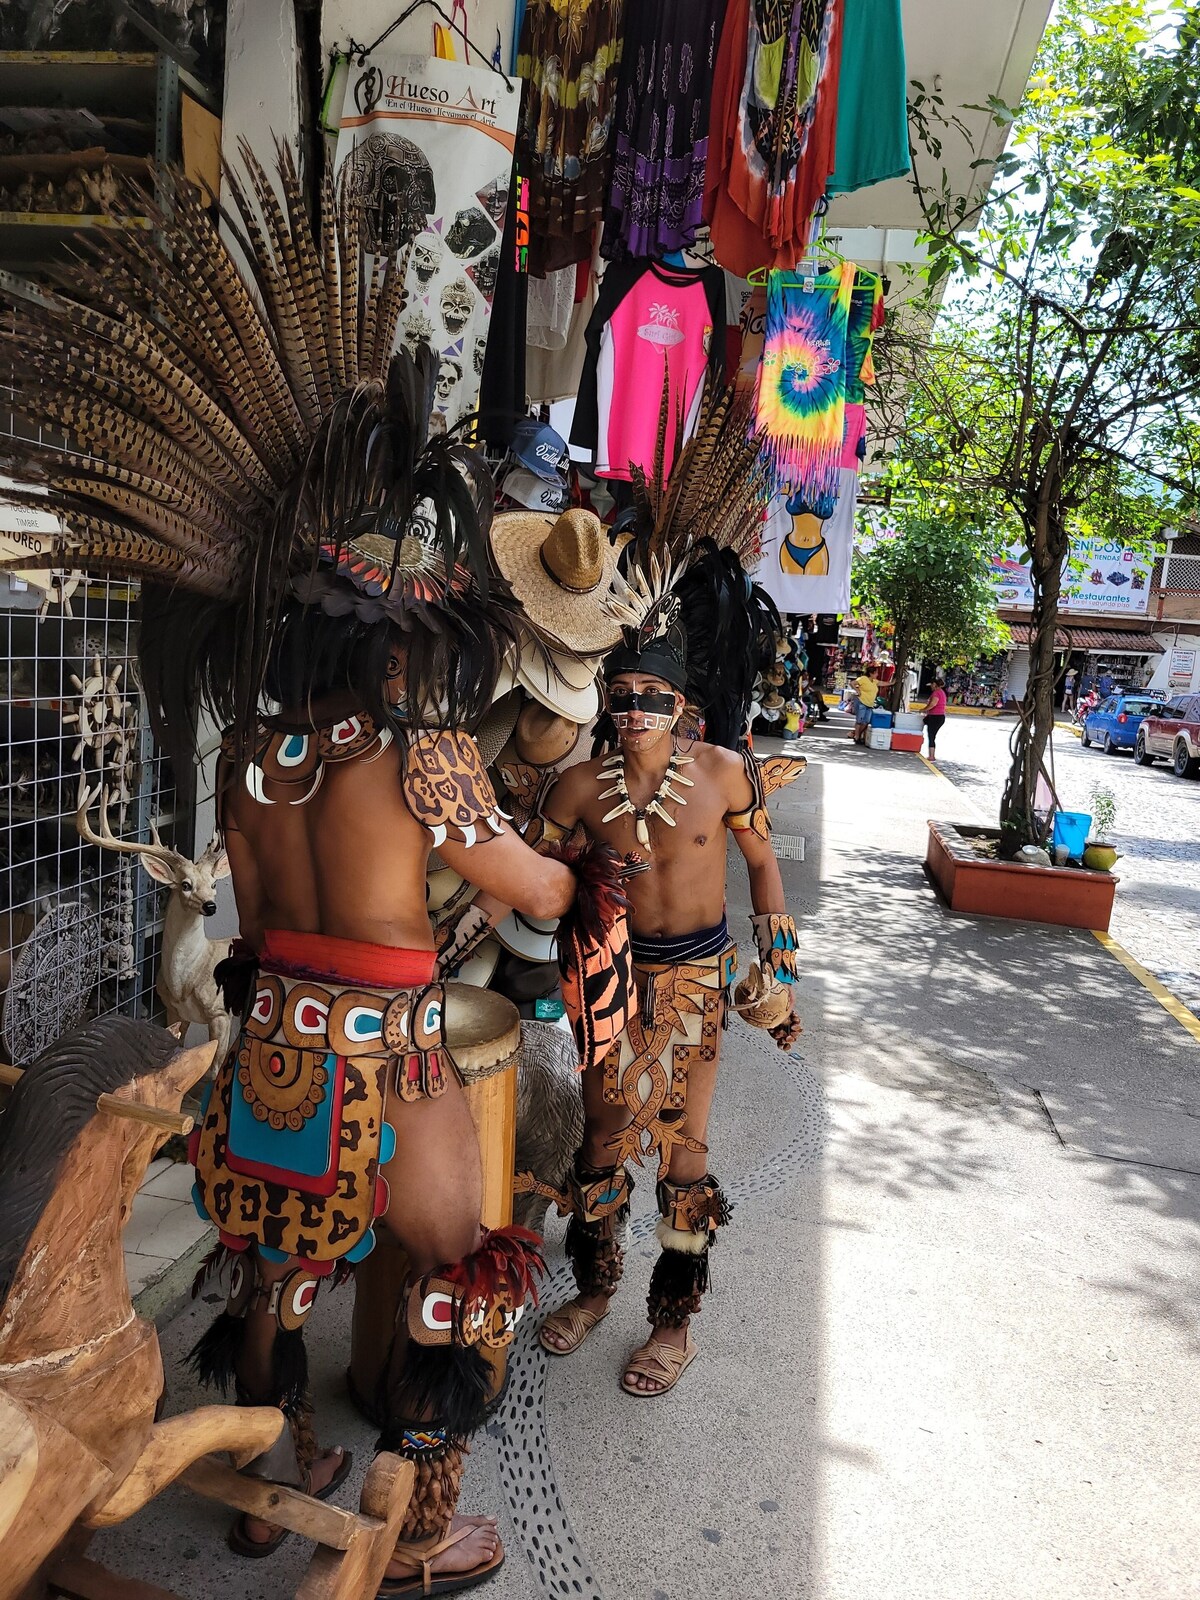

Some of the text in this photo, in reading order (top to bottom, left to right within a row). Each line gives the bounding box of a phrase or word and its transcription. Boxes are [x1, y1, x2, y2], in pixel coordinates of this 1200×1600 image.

[387, 75, 497, 114] Hueso Art
[386, 98, 398, 108] En
[407, 102, 432, 114] Hueso
[1072, 593, 1130, 603] Restaurantes
